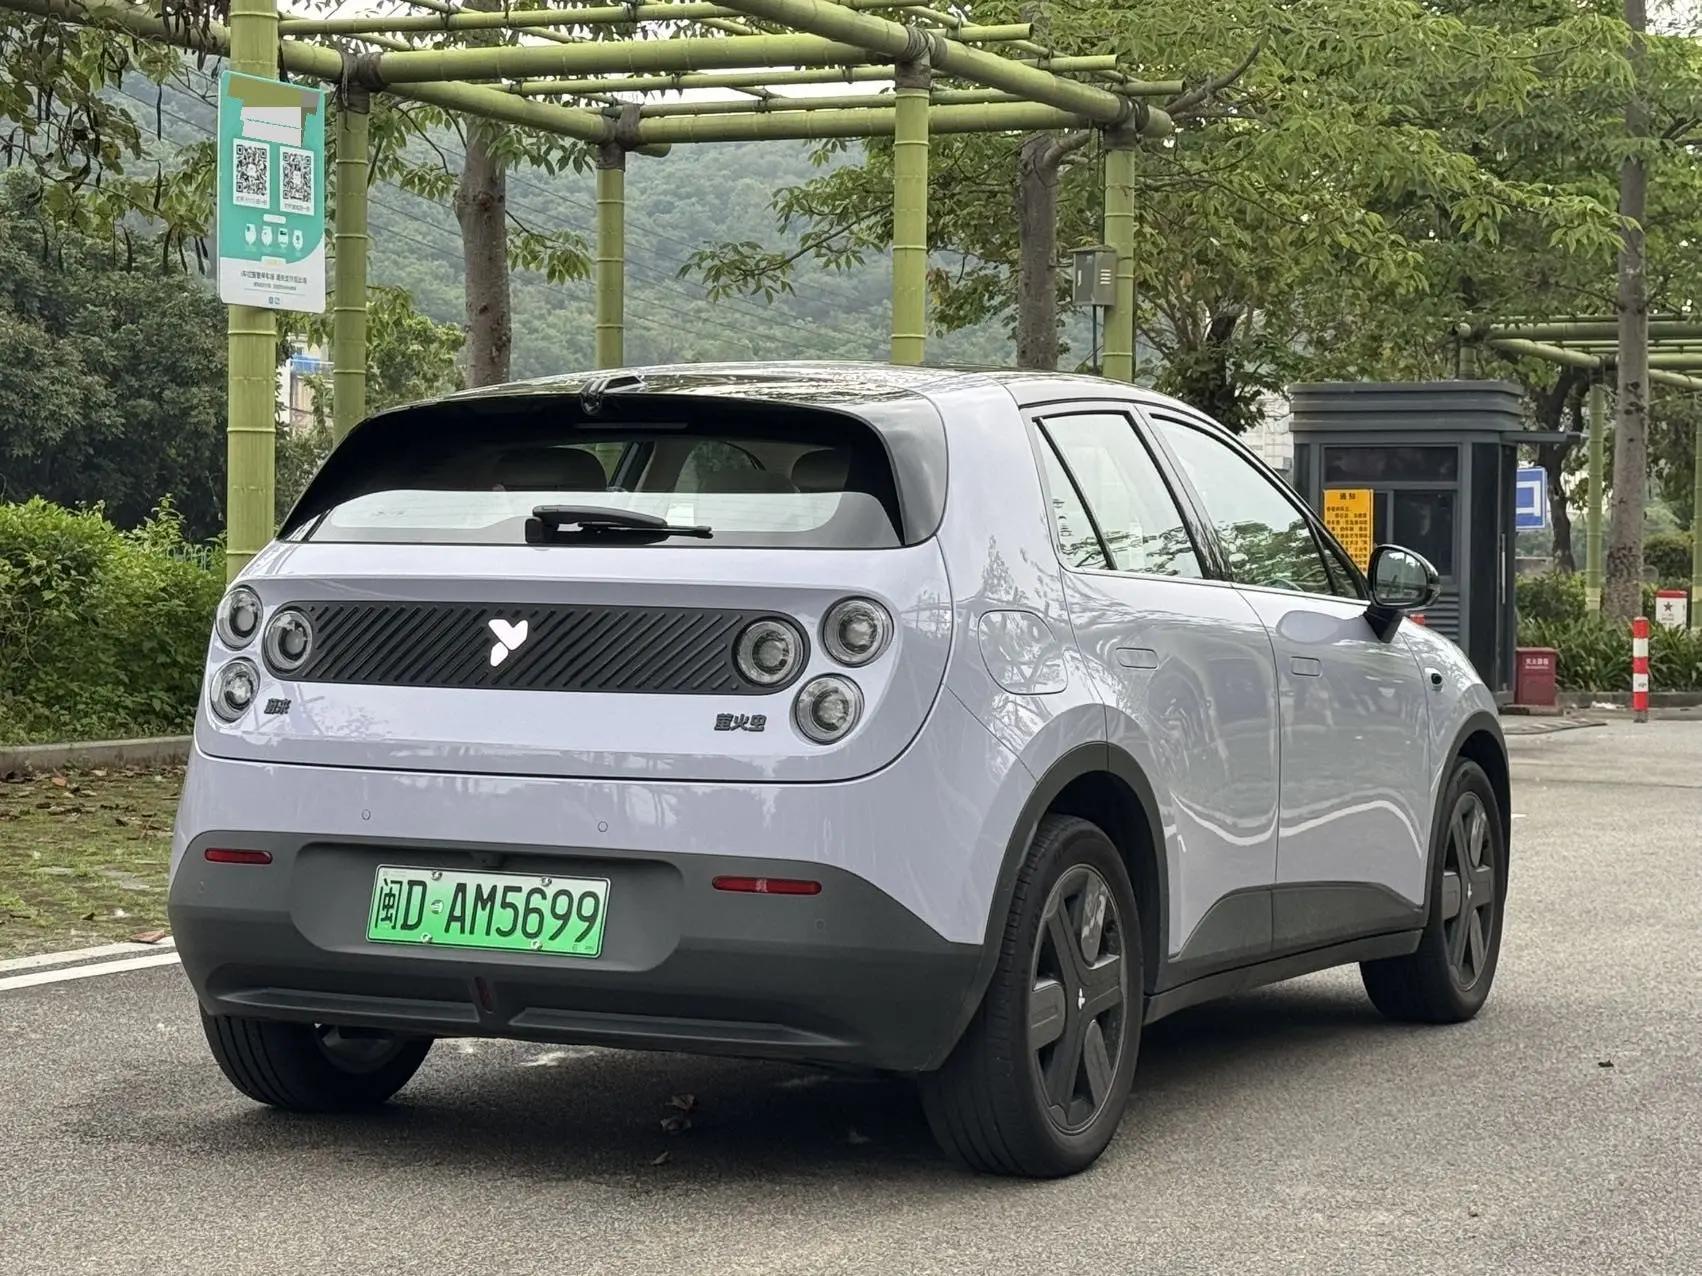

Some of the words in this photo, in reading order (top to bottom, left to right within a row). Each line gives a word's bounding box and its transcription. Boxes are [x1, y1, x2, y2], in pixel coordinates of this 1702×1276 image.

[714, 713, 767, 732] 萤火虫
[444, 882, 601, 943] AM5699
